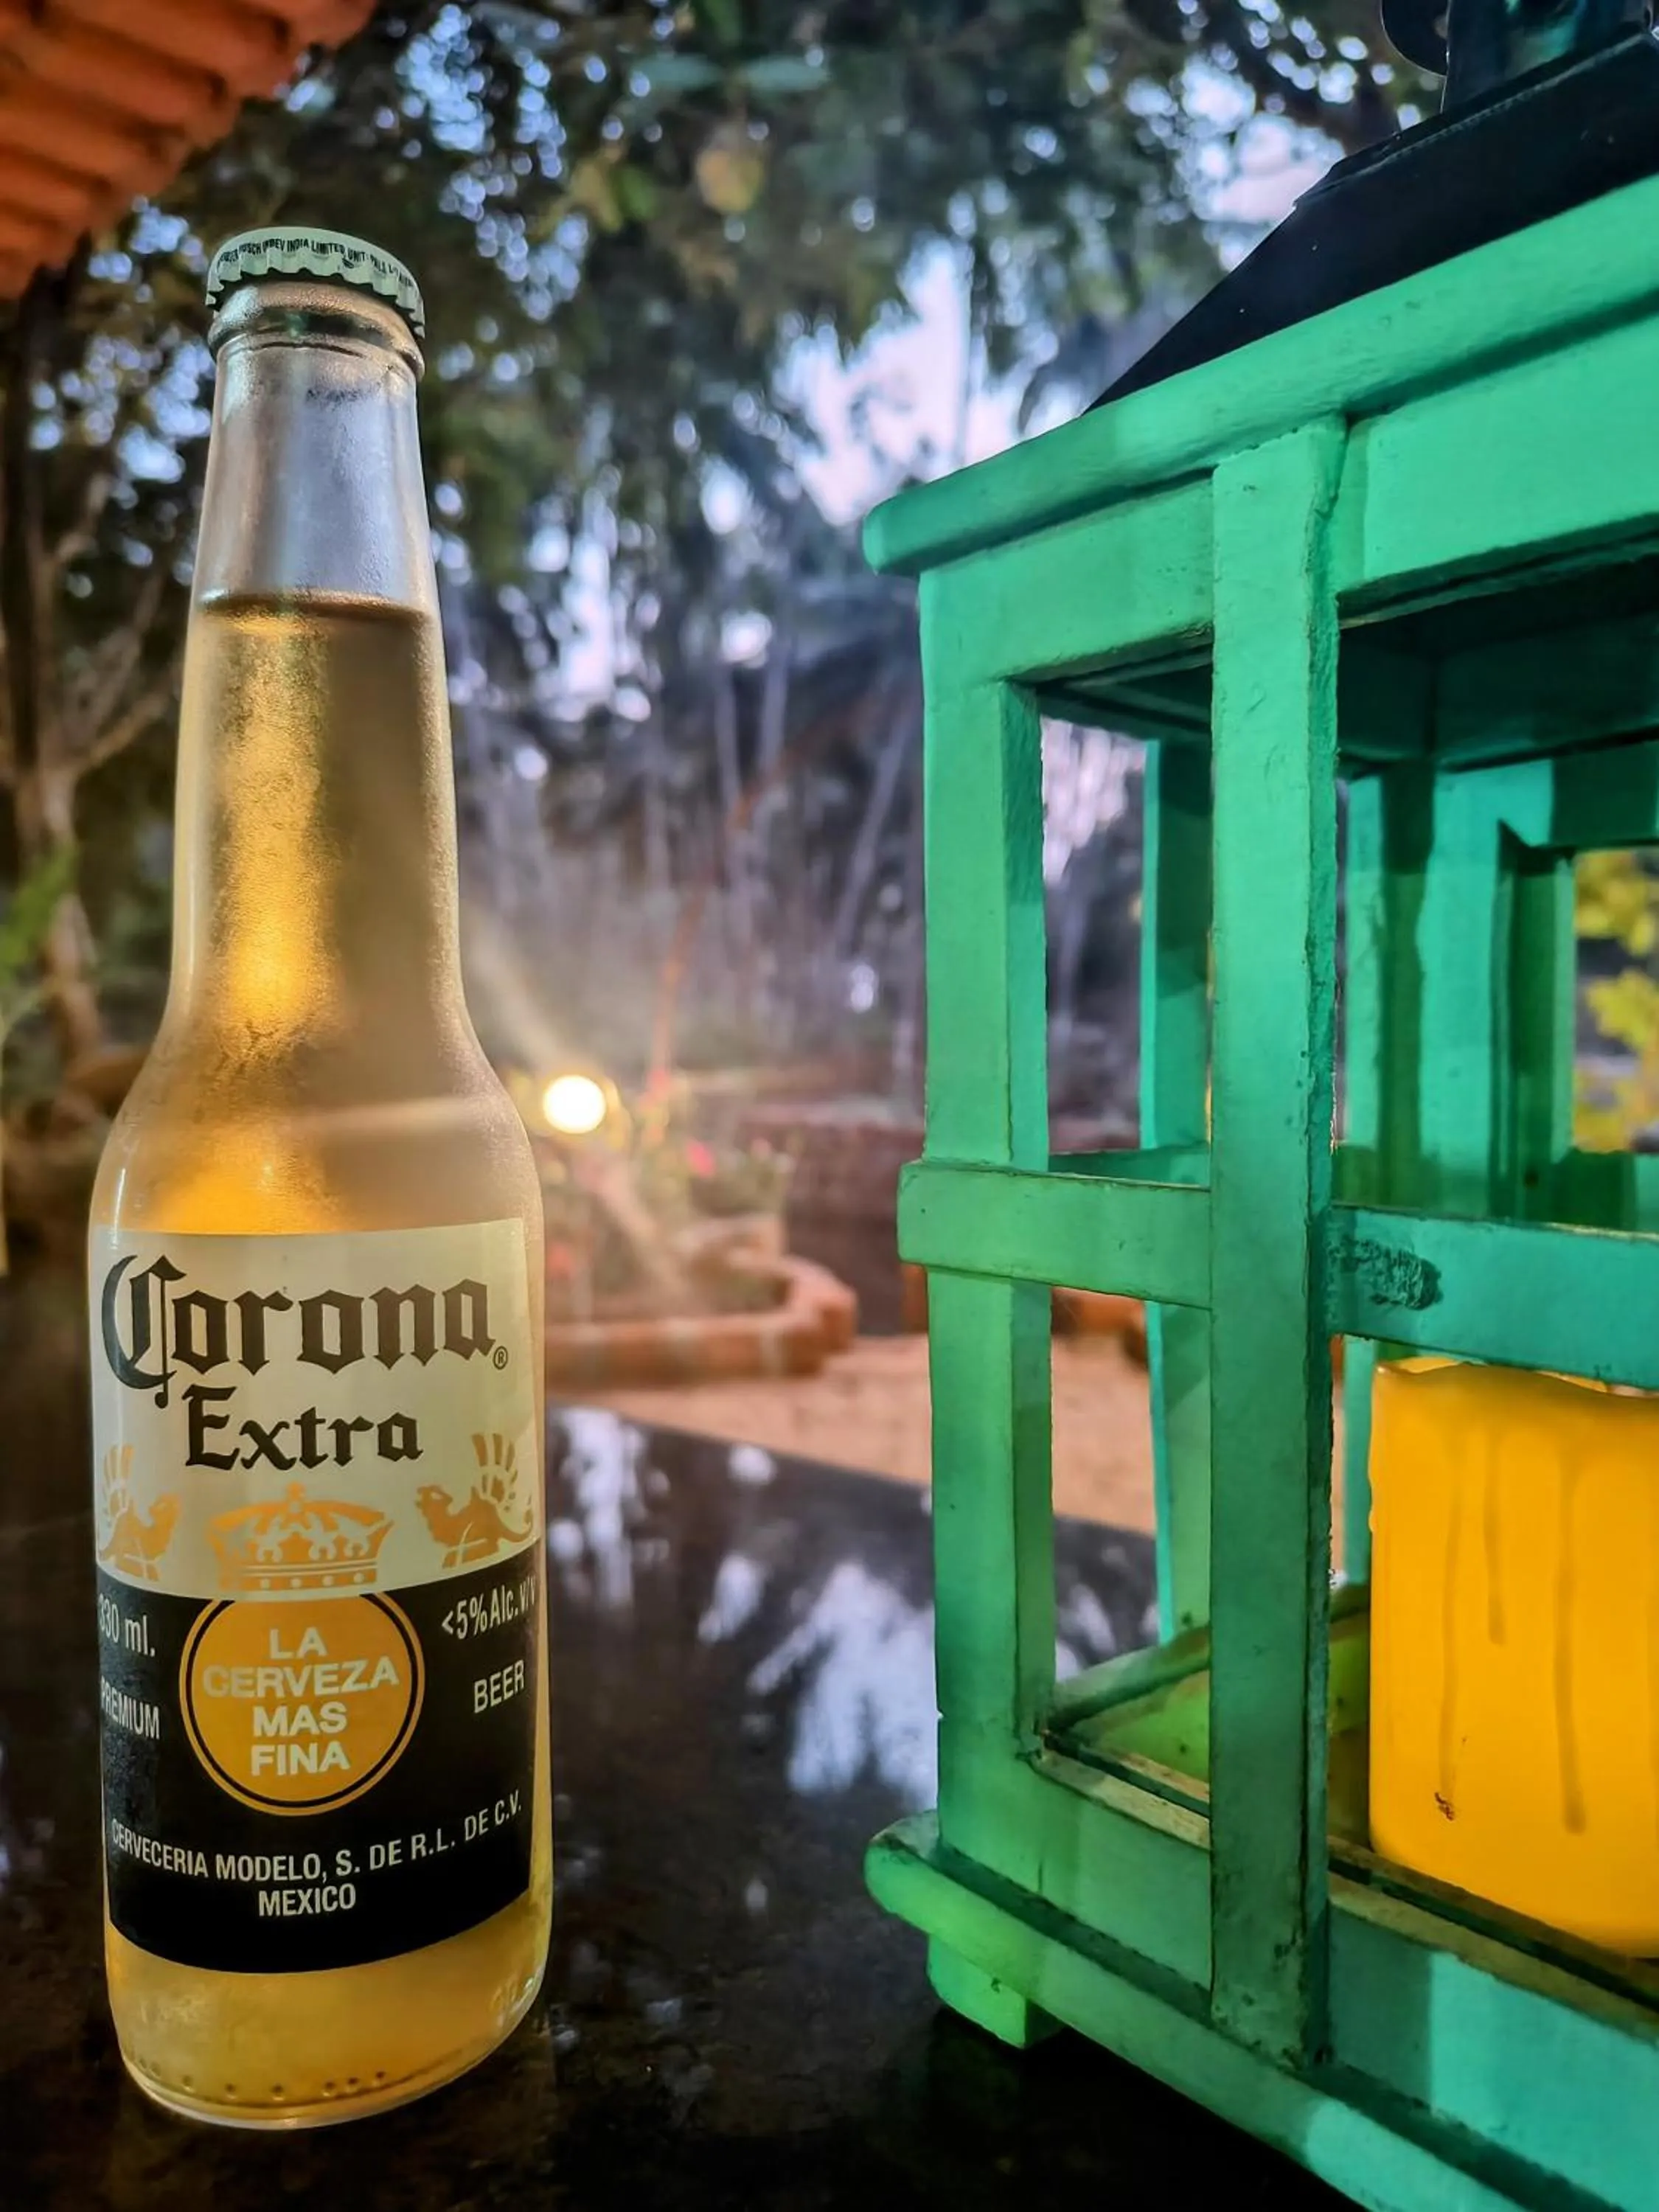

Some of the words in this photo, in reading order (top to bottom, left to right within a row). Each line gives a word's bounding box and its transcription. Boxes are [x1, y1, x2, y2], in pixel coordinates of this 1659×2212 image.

[287, 238, 309, 252] INDIA
[102, 1254, 497, 1409] Corona
[181, 1384, 424, 1471] Extra
[441, 1593, 487, 1640] <5%
[489, 1584, 519, 1629] Alc.
[125, 1615, 156, 1657] ml.
[270, 1627, 327, 1660] LA
[203, 1655, 400, 1698] CERVEZA
[473, 1660, 526, 1714] BEER
[100, 1674, 160, 1740] PREMIUM
[253, 1701, 347, 1737] MAS
[251, 1741, 350, 1776] FINA
[111, 1818, 209, 1878] CERVECERIA
[215, 1853, 327, 1885] MODELO,
[335, 1851, 361, 1877] S.
[369, 1839, 403, 1871] DE
[411, 1828, 456, 1861] R.L.
[465, 1808, 489, 1842] DE
[495, 1790, 522, 1826] C.V.
[258, 1883, 356, 1917] MEXICO
